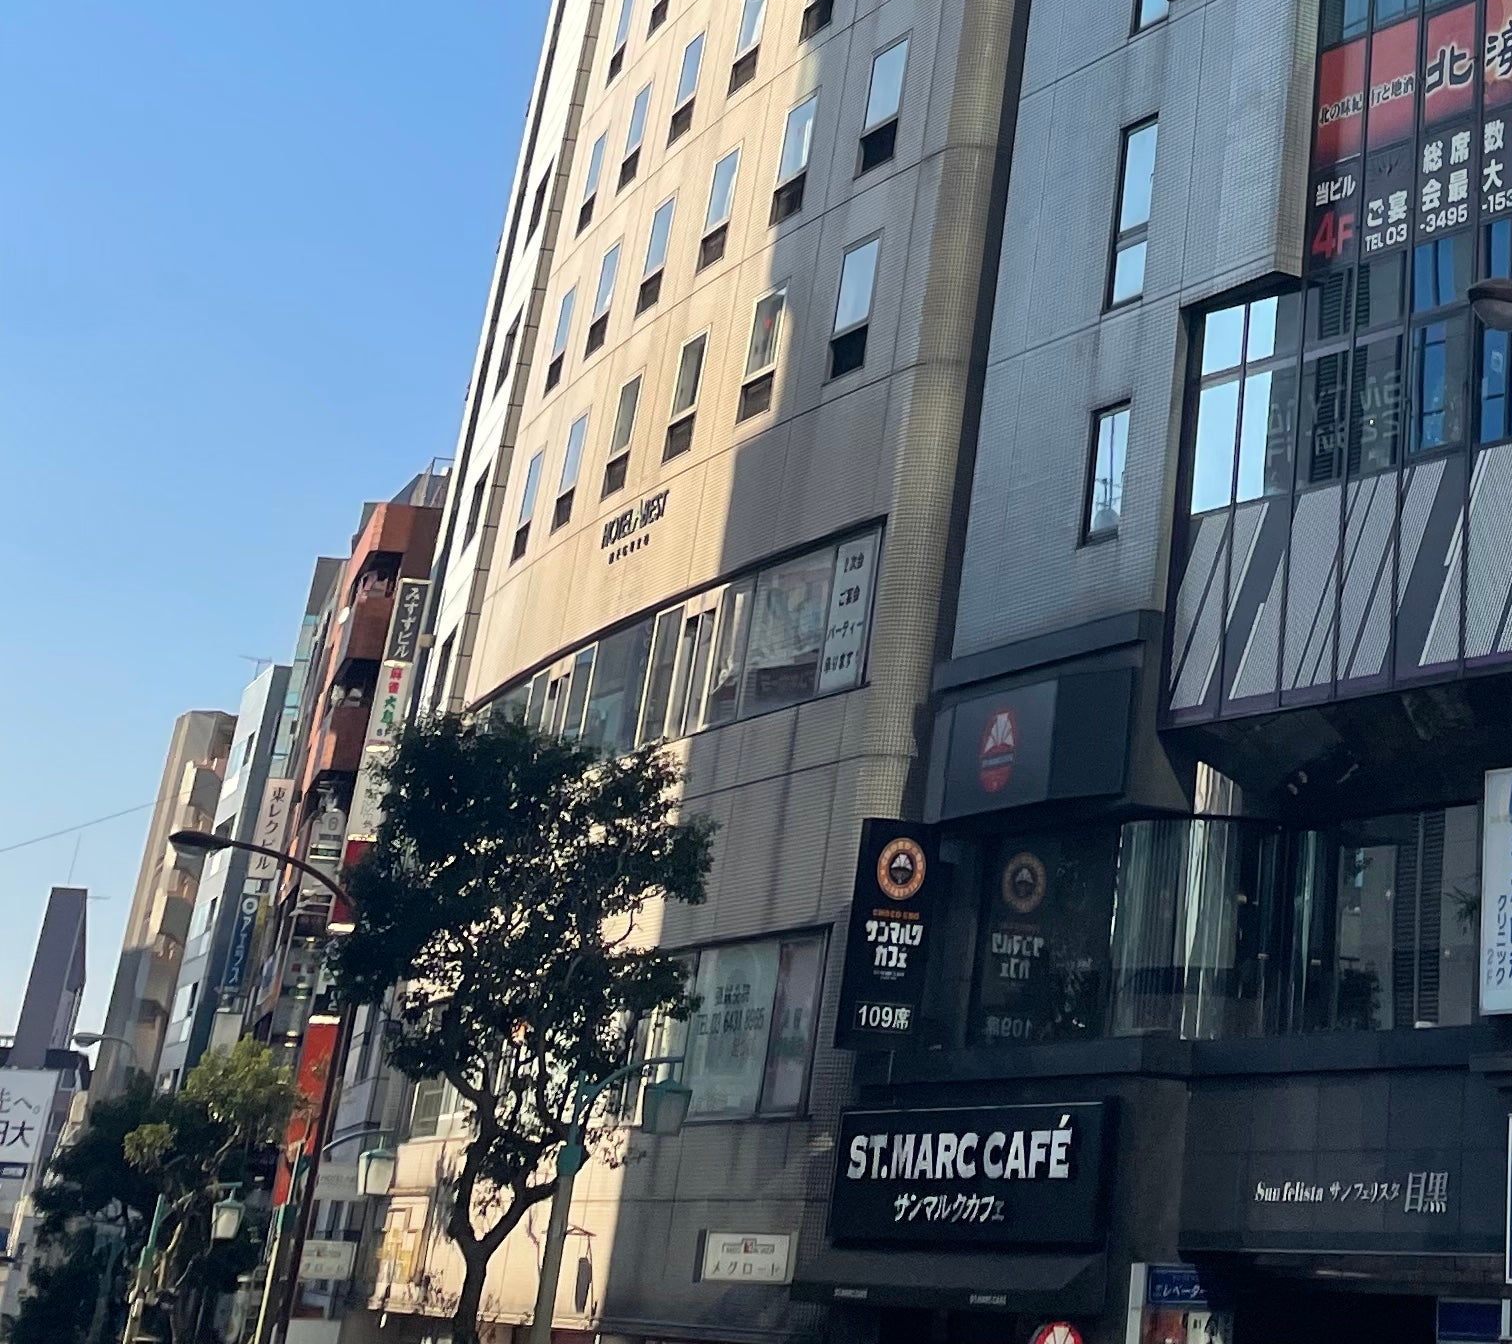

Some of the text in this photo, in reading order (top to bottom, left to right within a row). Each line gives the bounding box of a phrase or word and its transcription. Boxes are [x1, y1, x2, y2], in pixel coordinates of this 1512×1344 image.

[1316, 175, 1356, 207] 当ビル
[1312, 210, 1355, 259] 4F
[1365, 230, 1384, 252] TEL
[393, 587, 421, 659] みすずビル
[865, 919, 924, 946] サンマルク
[1495, 894, 1508, 986] クリニック
[874, 943, 909, 969] カフェ
[858, 1004, 911, 1031] 109席
[846, 1114, 1074, 1181] ST.MARC CAFÉ
[1403, 1170, 1449, 1213] 目黒
[894, 1193, 1006, 1222] サンマルクカフェ
[712, 1260, 779, 1277] メグロード
